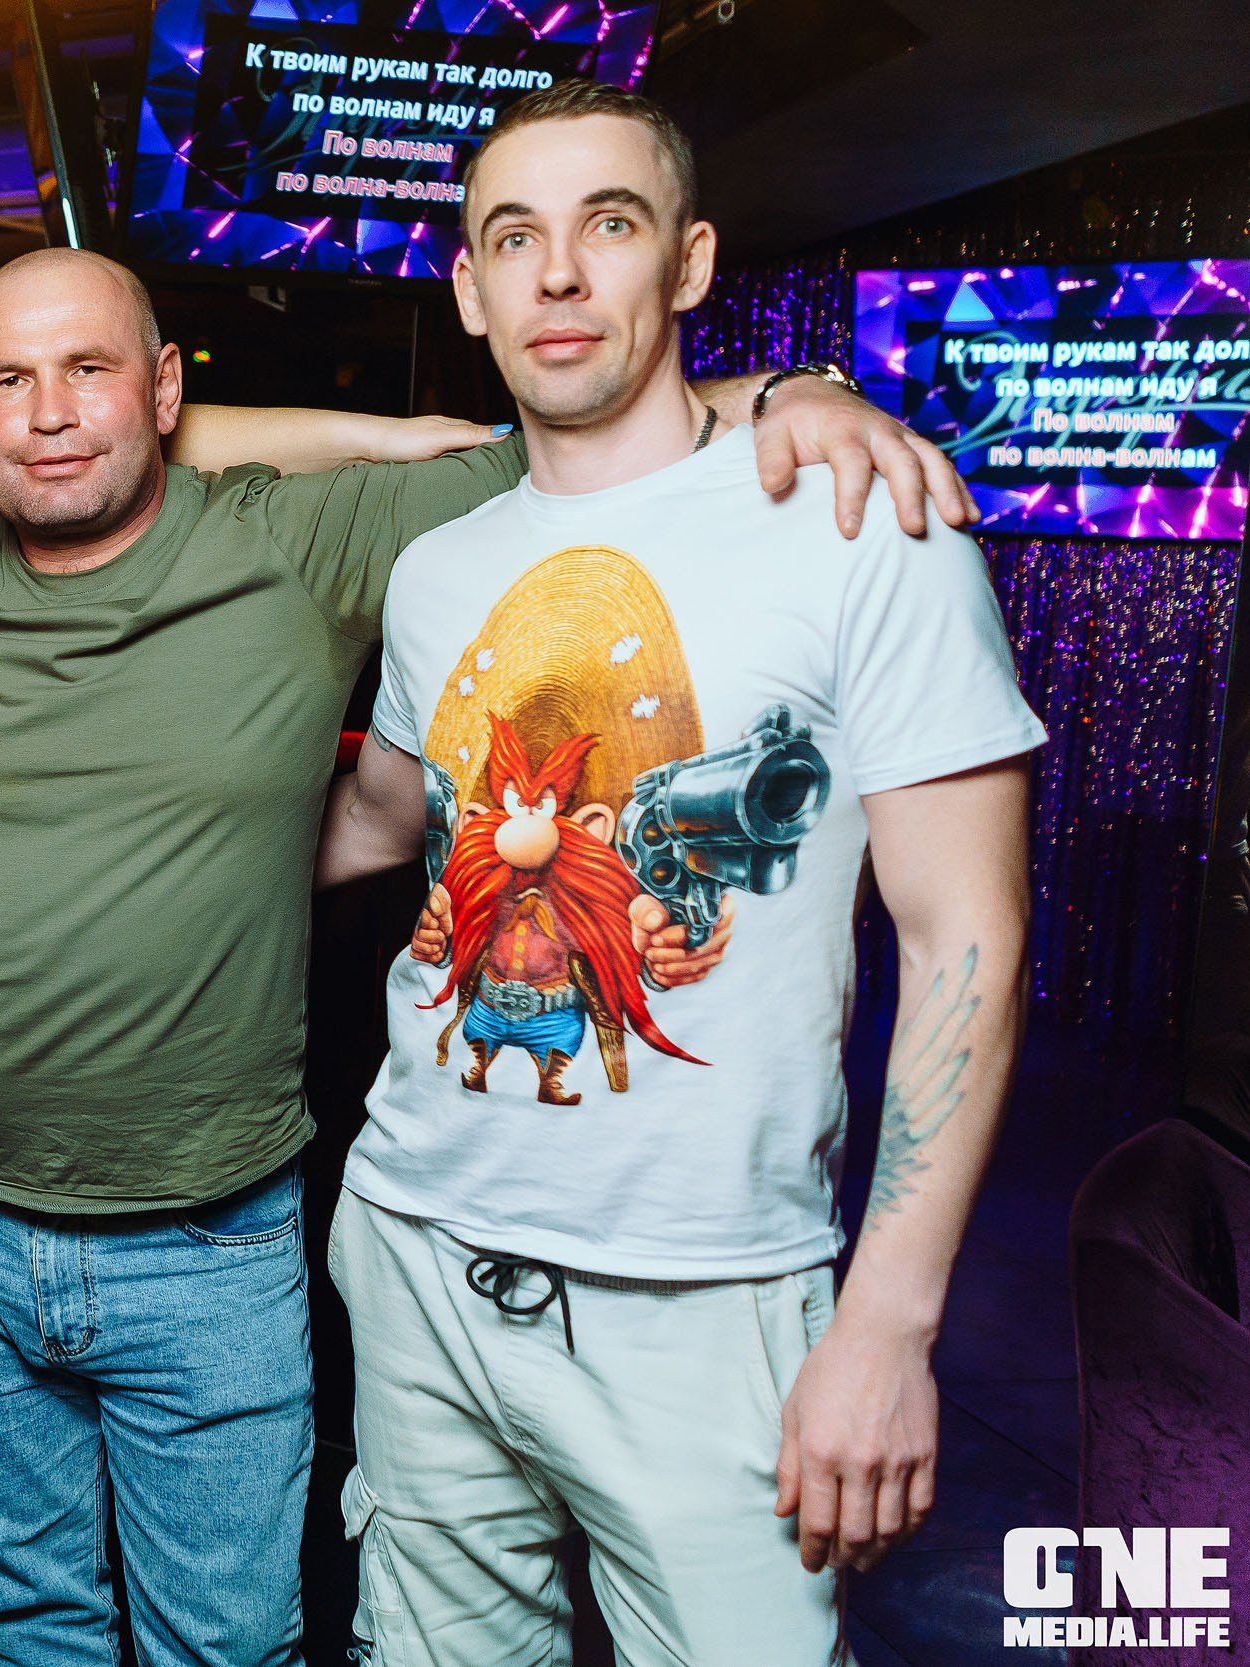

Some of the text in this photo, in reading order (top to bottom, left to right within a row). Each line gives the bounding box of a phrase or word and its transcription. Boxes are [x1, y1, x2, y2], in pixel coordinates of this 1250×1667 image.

[246, 43, 553, 89] К твоим рукам так долго
[293, 93, 496, 130] по волнам иду я
[322, 129, 454, 163] По волнам
[276, 171, 466, 203] по волна-волна
[944, 339, 1250, 367] К твоим рукам так дол
[996, 376, 1218, 401] по волнам иду я
[1032, 408, 1175, 433] По волнам
[988, 446, 1216, 468] по волна-волнам
